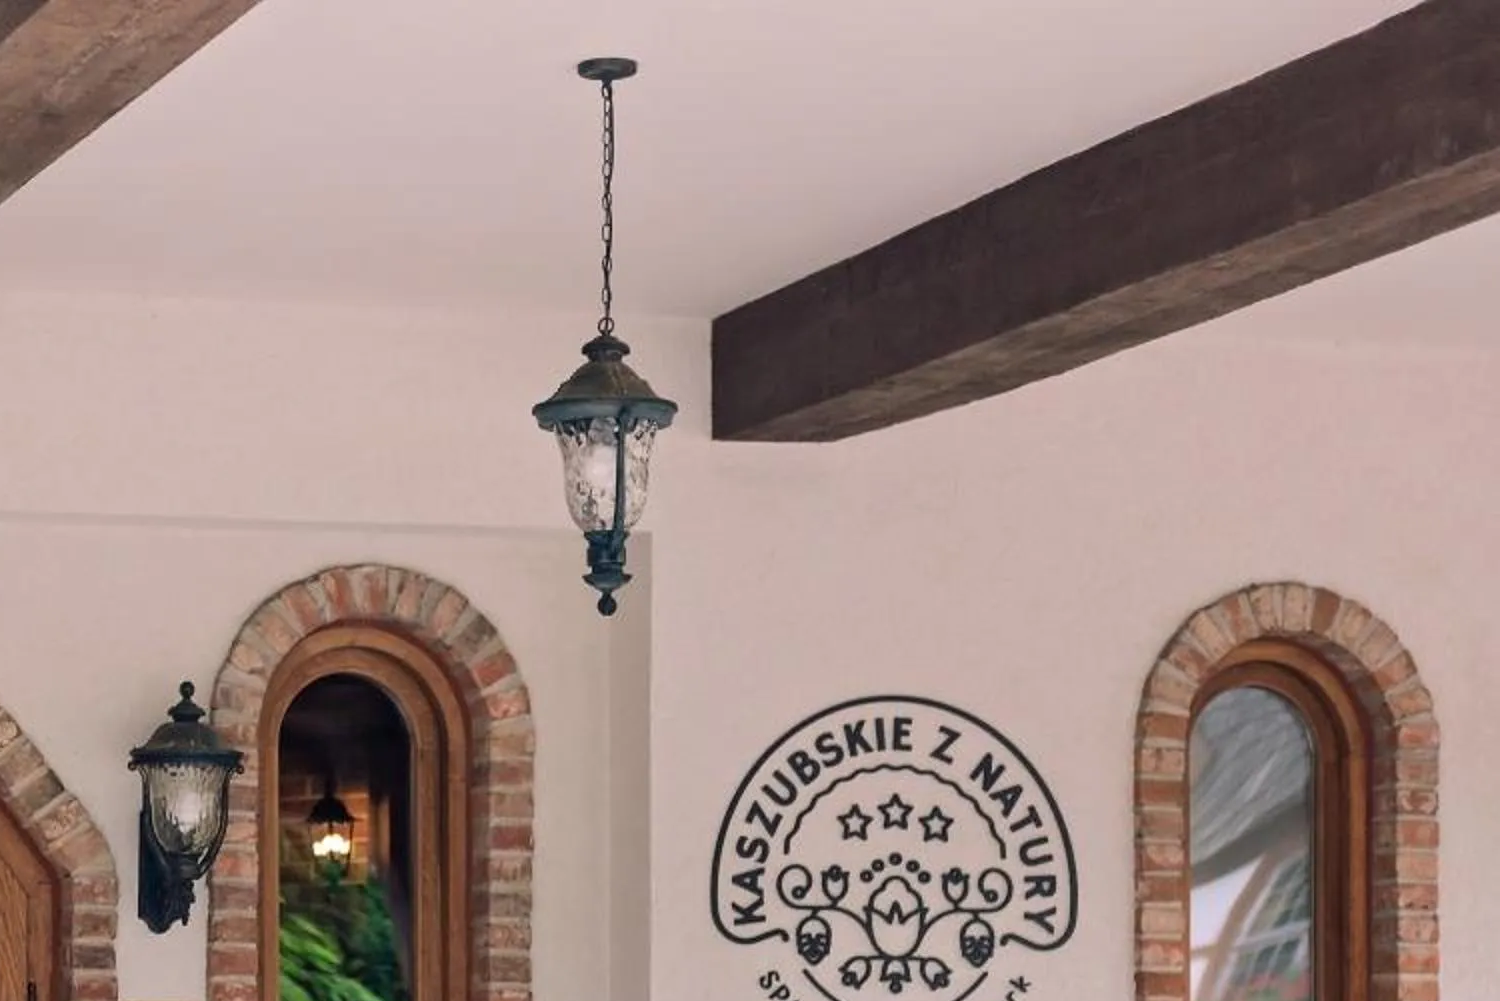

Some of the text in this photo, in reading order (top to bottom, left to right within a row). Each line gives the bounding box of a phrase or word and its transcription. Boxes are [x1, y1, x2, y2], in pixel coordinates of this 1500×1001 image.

[730, 716, 1058, 936] KASZUBSKIE Z NATURY
